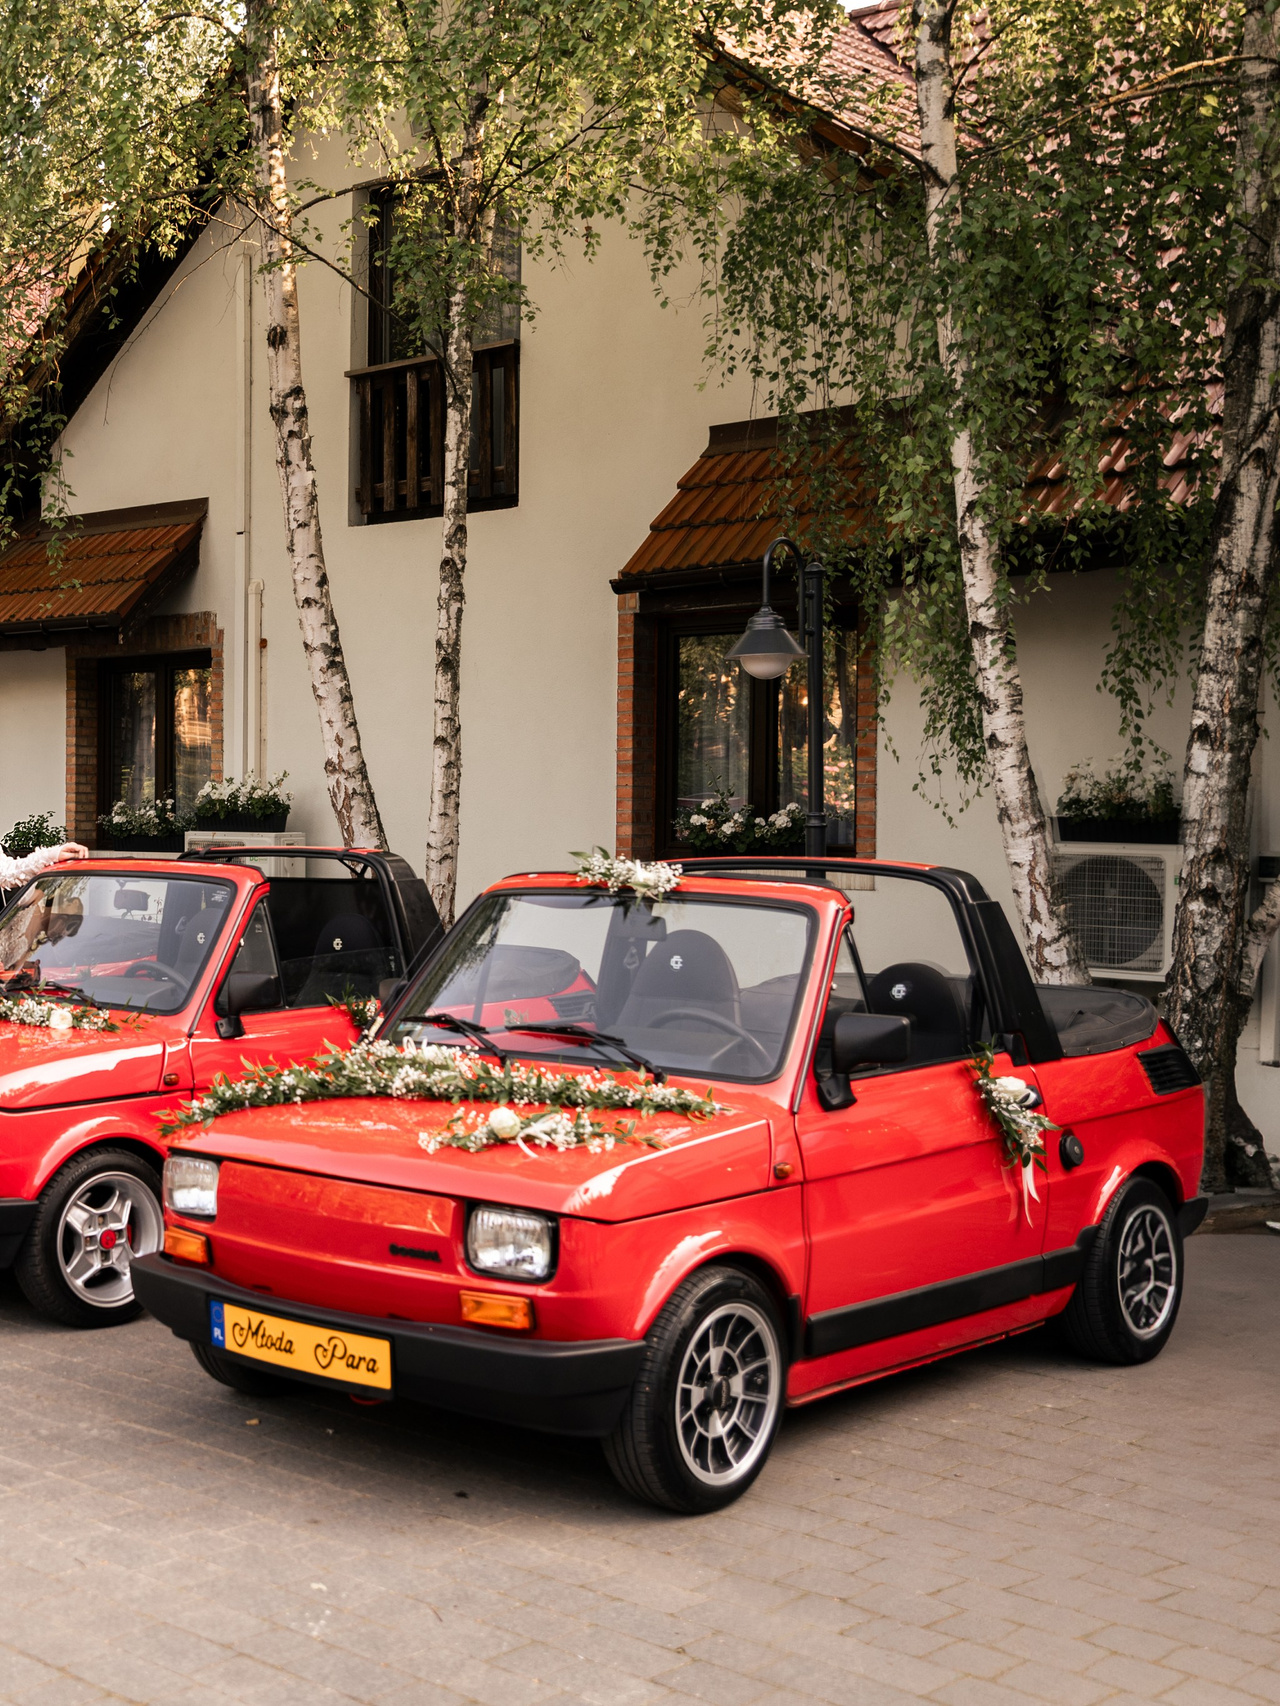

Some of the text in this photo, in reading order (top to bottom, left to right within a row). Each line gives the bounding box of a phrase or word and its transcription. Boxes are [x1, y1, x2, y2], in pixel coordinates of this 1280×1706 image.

[213, 1327, 224, 1340] PL
[232, 1316, 379, 1373] Młoda Para
